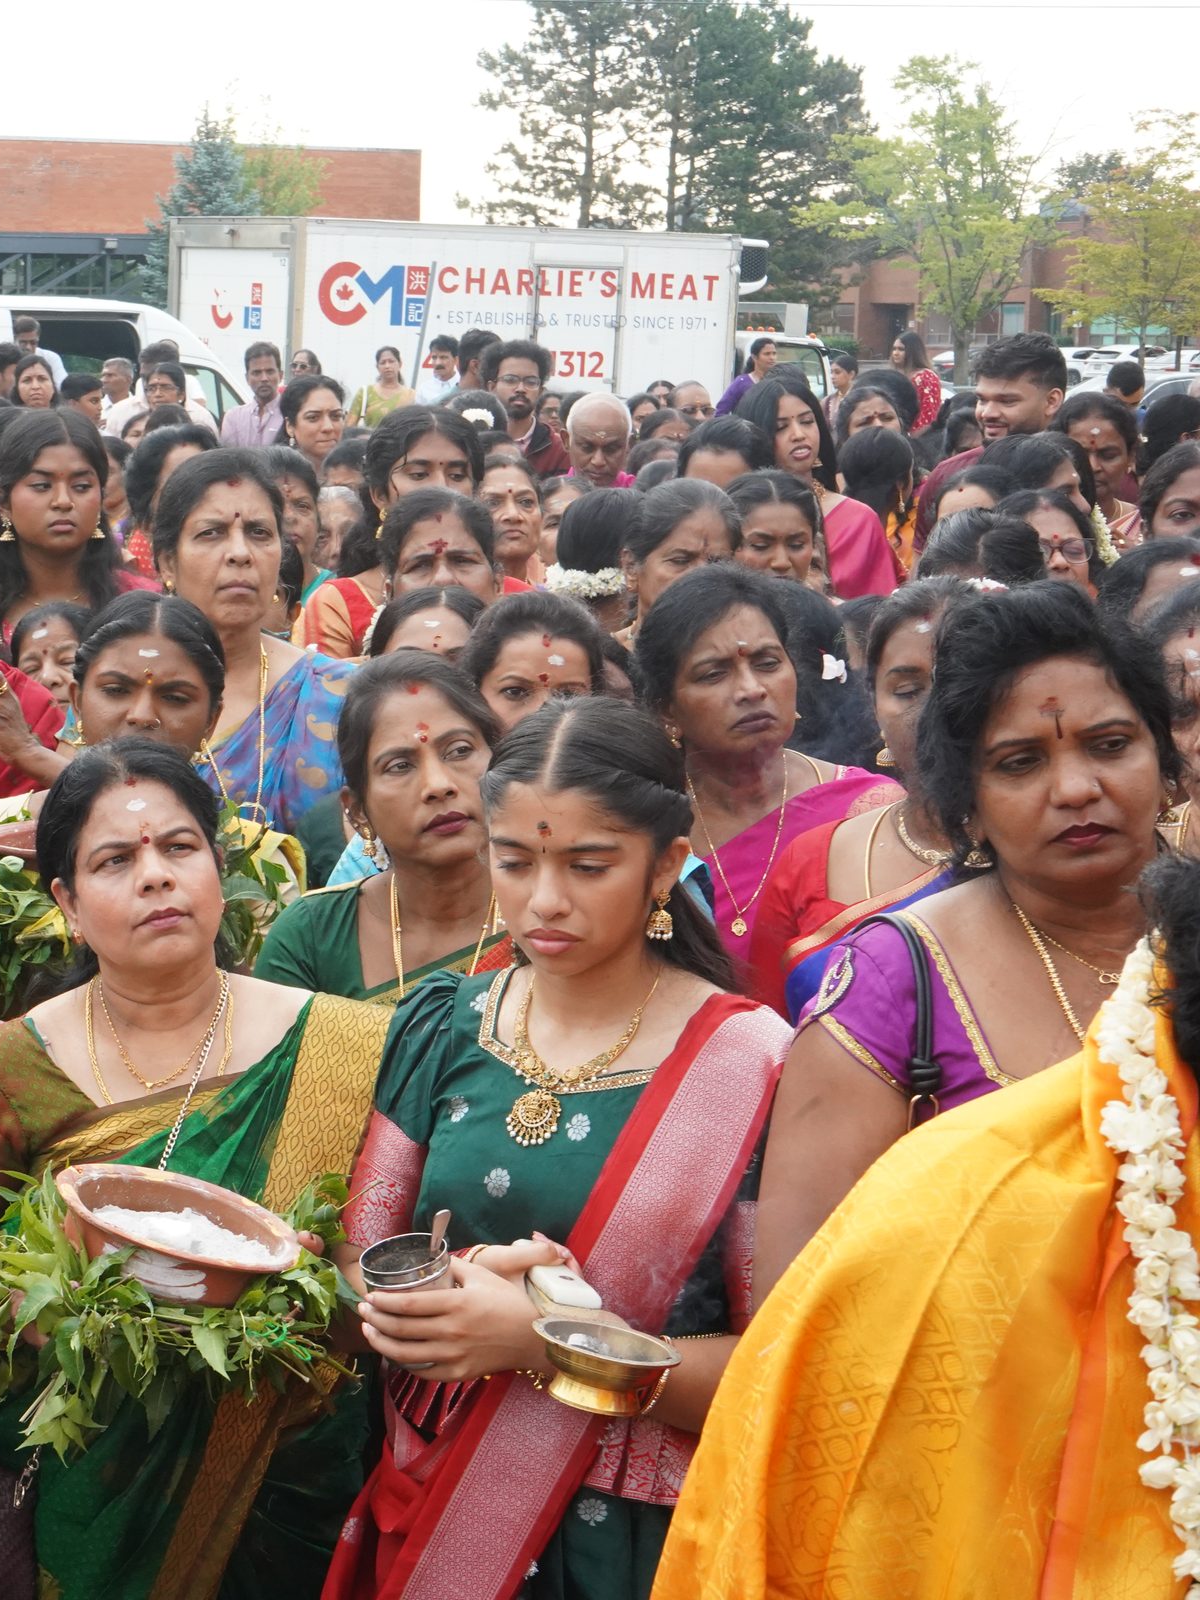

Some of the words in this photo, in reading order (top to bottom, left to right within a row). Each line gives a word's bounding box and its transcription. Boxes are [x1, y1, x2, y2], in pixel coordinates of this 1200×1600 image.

[438, 266, 619, 298] CHARLIE'S
[631, 272, 720, 301] MEAT
[447, 310, 545, 326] ESTABLISHED
[549, 312, 559, 326] &
[566, 313, 628, 329] TRUSTED
[633, 315, 674, 330] SINCE
[680, 316, 707, 330] 1971
